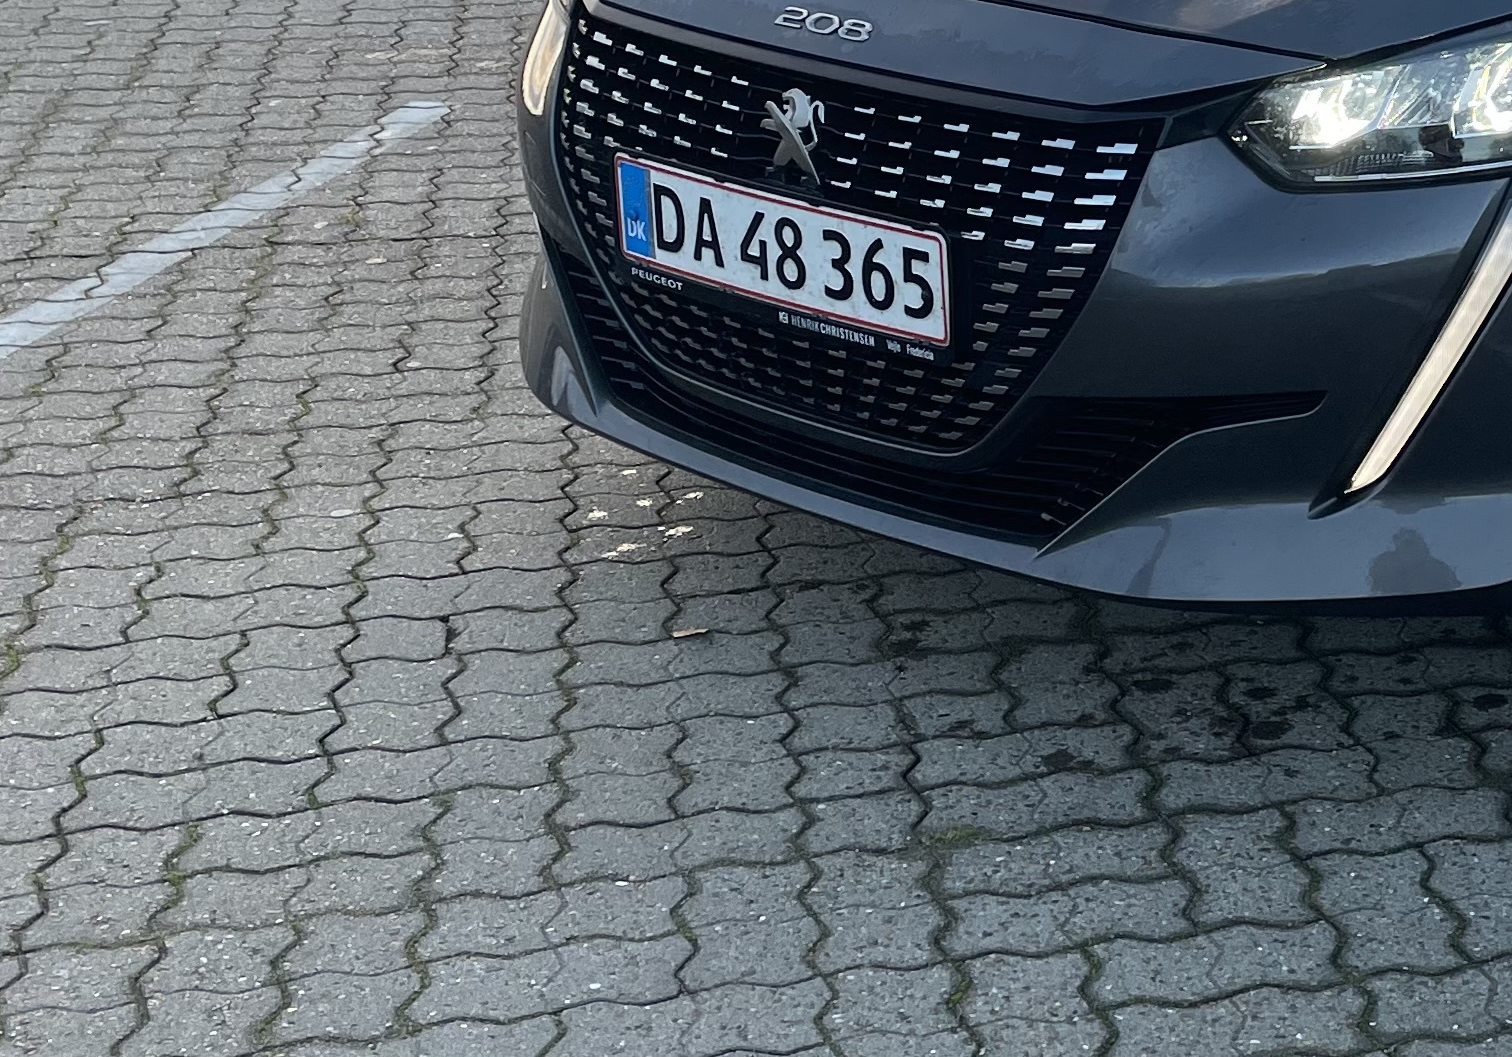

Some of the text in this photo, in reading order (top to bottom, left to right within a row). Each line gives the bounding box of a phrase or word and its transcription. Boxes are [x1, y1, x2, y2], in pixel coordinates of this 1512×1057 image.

[774, 6, 874, 42] 208
[627, 217, 647, 242] DK
[652, 182, 934, 319] DA 48 365
[631, 267, 683, 291] PEUGEOT
